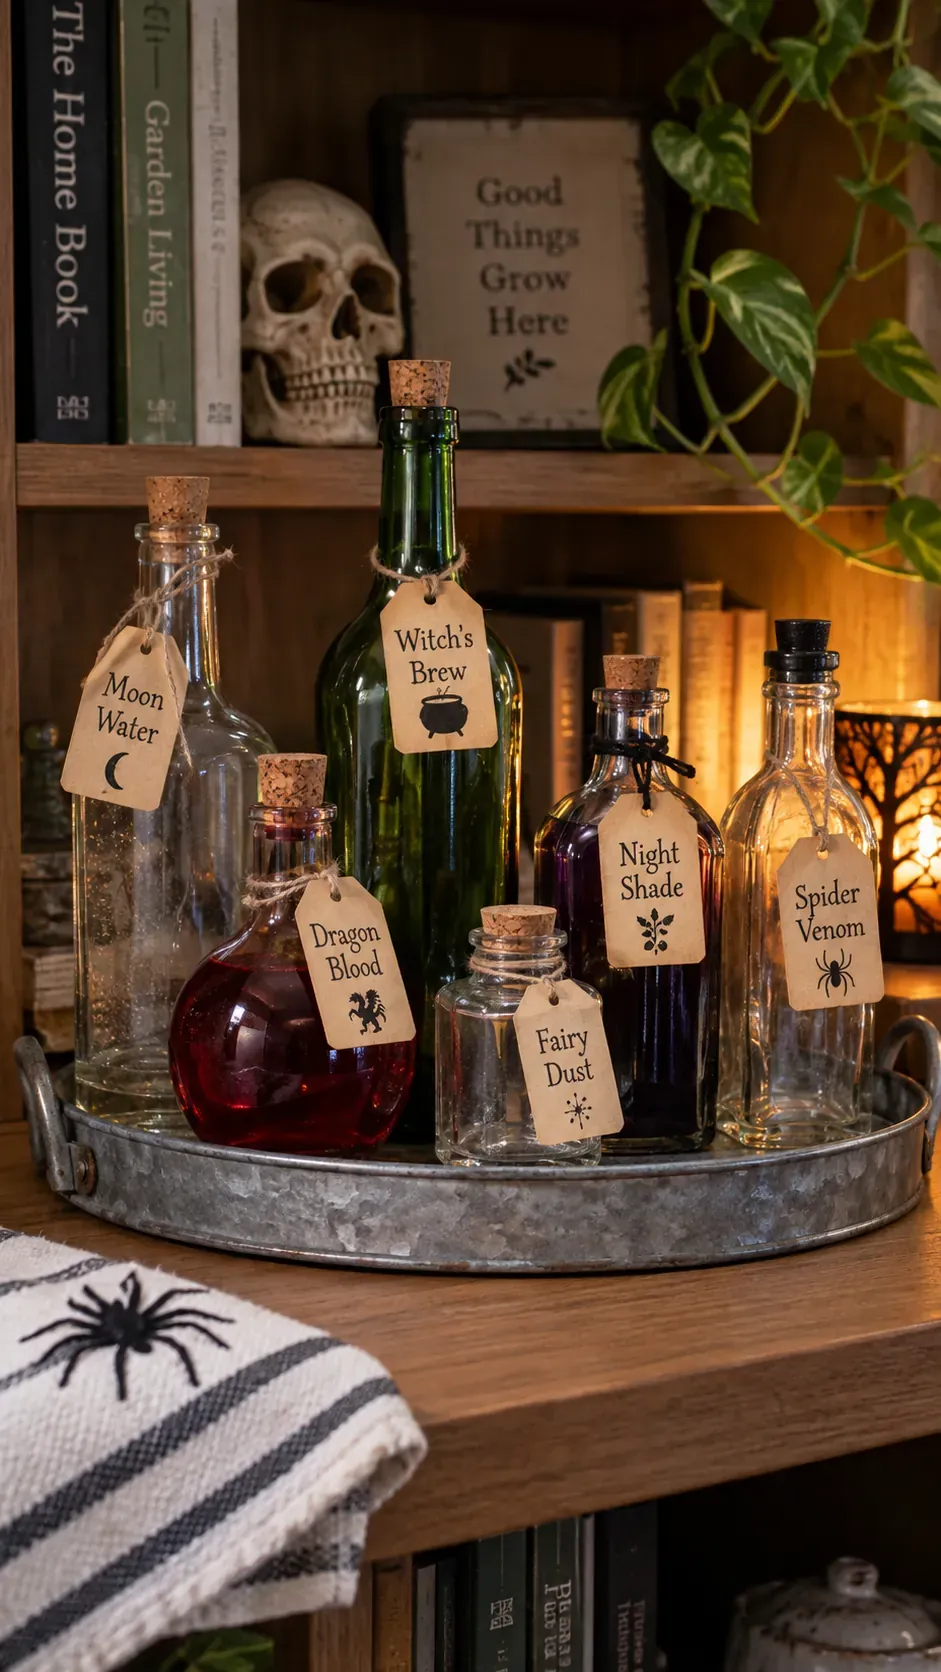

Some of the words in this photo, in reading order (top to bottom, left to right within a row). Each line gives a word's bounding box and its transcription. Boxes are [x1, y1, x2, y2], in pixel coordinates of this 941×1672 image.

[53, 2, 85, 76] The
[53, 89, 86, 211] Home
[145, 101, 173, 217] Garden
[476, 173, 564, 207] Good
[466, 218, 580, 257] Things
[55, 224, 89, 329] Book
[143, 229, 174, 328] Living
[480, 262, 571, 294] Grow
[489, 305, 569, 336] Here
[394, 624, 474, 653] Witch's
[410, 660, 467, 685] Brew
[103, 671, 164, 711] Moon
[97, 705, 159, 745] Water
[618, 838, 681, 874] Night
[620, 871, 684, 900] Shade
[795, 880, 860, 917] Spider
[308, 922, 381, 954] Dragon
[796, 914, 866, 943] Venom
[326, 949, 383, 981] Blood
[536, 1028, 589, 1060] Fairy
[545, 1057, 594, 1087] Dust
